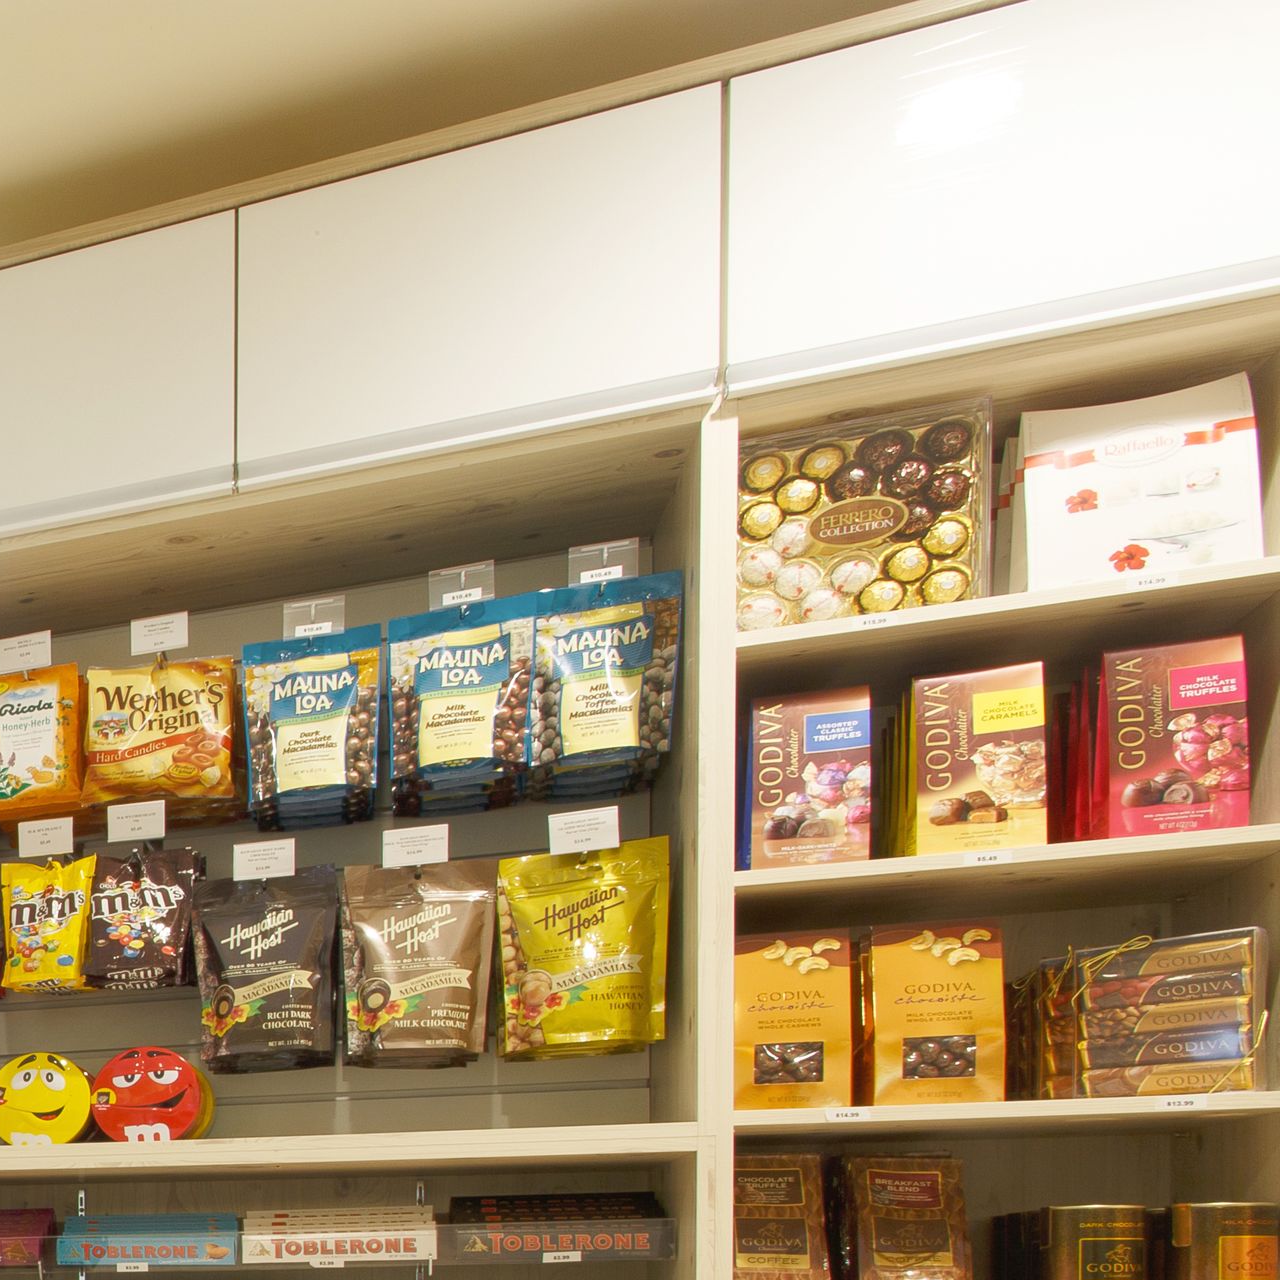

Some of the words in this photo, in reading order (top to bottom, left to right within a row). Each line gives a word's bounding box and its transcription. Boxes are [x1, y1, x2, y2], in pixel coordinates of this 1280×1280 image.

[1104, 435, 1176, 460] Raffaello
[820, 505, 896, 530] FERRERO
[819, 518, 895, 539] COLLECTION
[589, 570, 612, 579] $10.49
[451, 593, 472, 601] $10.49
[557, 621, 650, 656] MAUNA
[419, 642, 508, 674] MAUNA
[582, 647, 624, 669] LOA
[273, 671, 355, 701] MAUNA
[440, 666, 482, 687] LOA
[1179, 679, 1237, 690] CHOCOLATE
[1196, 675, 1219, 684] MILK
[96, 681, 225, 712] Werther's
[1179, 685, 1237, 698] TRUFFLES
[294, 695, 333, 716] LOA
[569, 705, 633, 720] Macadamias
[584, 698, 617, 709] Toffee
[983, 704, 1035, 714] CHOCOLATE
[1117, 657, 1145, 770] GODIVA
[1148, 684, 1164, 738] Chocolatier
[1, 717, 51, 732] Honey-Herb
[425, 715, 485, 729] Macadamias
[431, 708, 479, 721] Chocolate
[981, 709, 1039, 722] CARAMELS
[813, 730, 862, 743] TRUFFLES
[815, 720, 859, 733] ASSORTED
[925, 682, 951, 792] GODIVA
[954, 709, 968, 762] Chocolatier
[95, 751, 122, 763] Hard
[124, 739, 167, 759] Candies
[758, 703, 783, 807] GODIVA
[786, 729, 800, 780] Chocolatier
[10, 889, 86, 928] m&m's
[91, 885, 184, 916] m&m's
[534, 887, 618, 930] Hawaiian
[221, 908, 293, 949] Hawaiian
[378, 903, 451, 943] Hawaiian
[1156, 951, 1233, 971] GODIVA
[398, 975, 463, 997] MACADAMIAS
[555, 960, 635, 991] MACADAMIAS
[241, 976, 304, 1002] MACADAMIAS
[1156, 979, 1233, 999] GODIVA
[1152, 1007, 1230, 1027] GODIVA
[1153, 1037, 1230, 1055] GODIVA
[875, 1178, 932, 1190] BREAKFAST
[887, 1185, 920, 1193] BLEND
[80, 1242, 199, 1261] TOBLERONE
[269, 1236, 418, 1259] TOBLERONE
[487, 1233, 651, 1254] TOBLERONE
[741, 1237, 803, 1250] GODIVA
[746, 1256, 800, 1265] COFFEE
